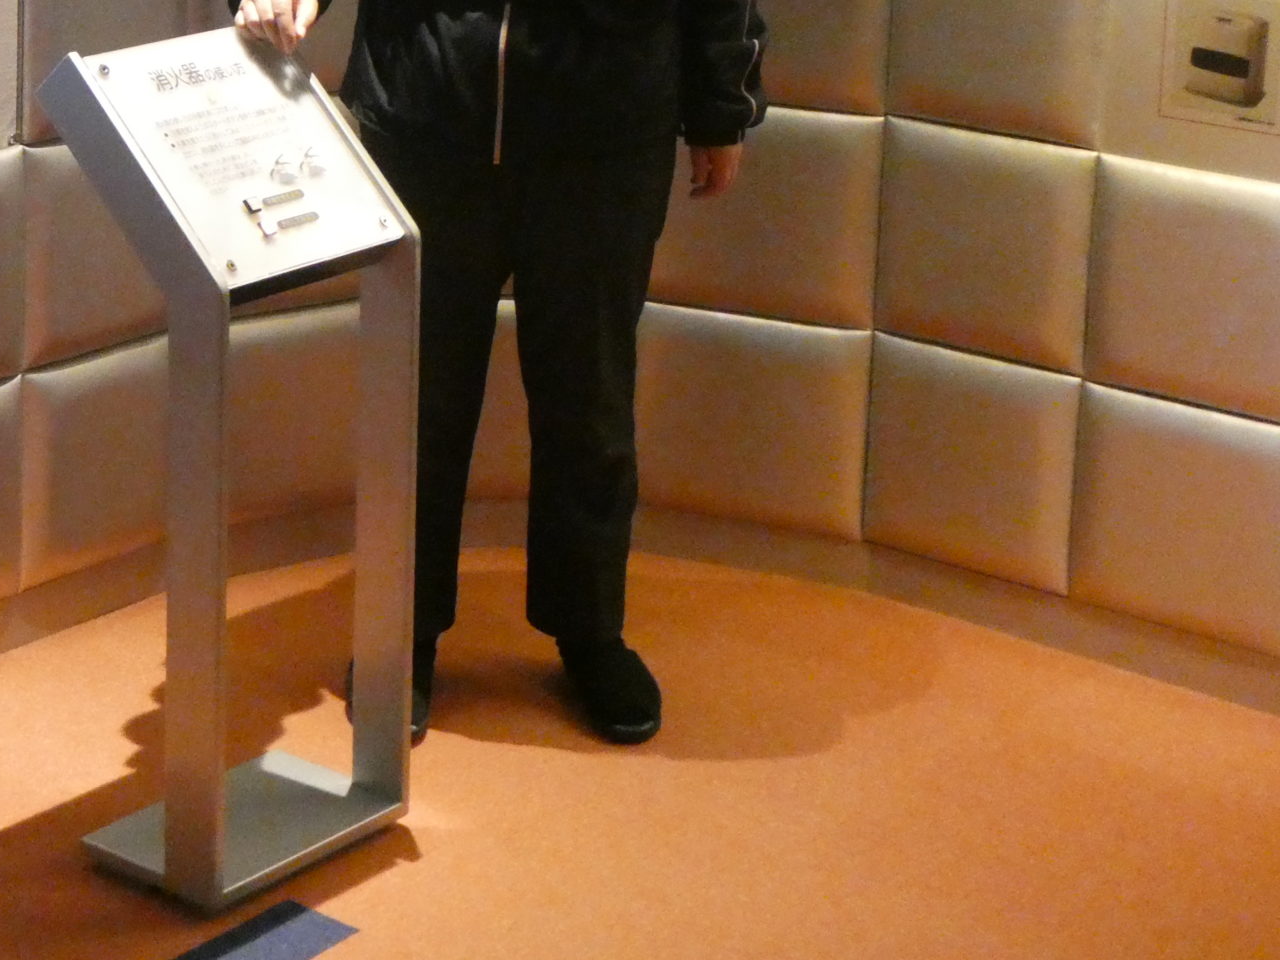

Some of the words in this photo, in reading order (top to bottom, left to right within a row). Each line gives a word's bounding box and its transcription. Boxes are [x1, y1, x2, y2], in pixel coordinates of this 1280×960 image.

[148, 62, 247, 92] 消火器の使い方
